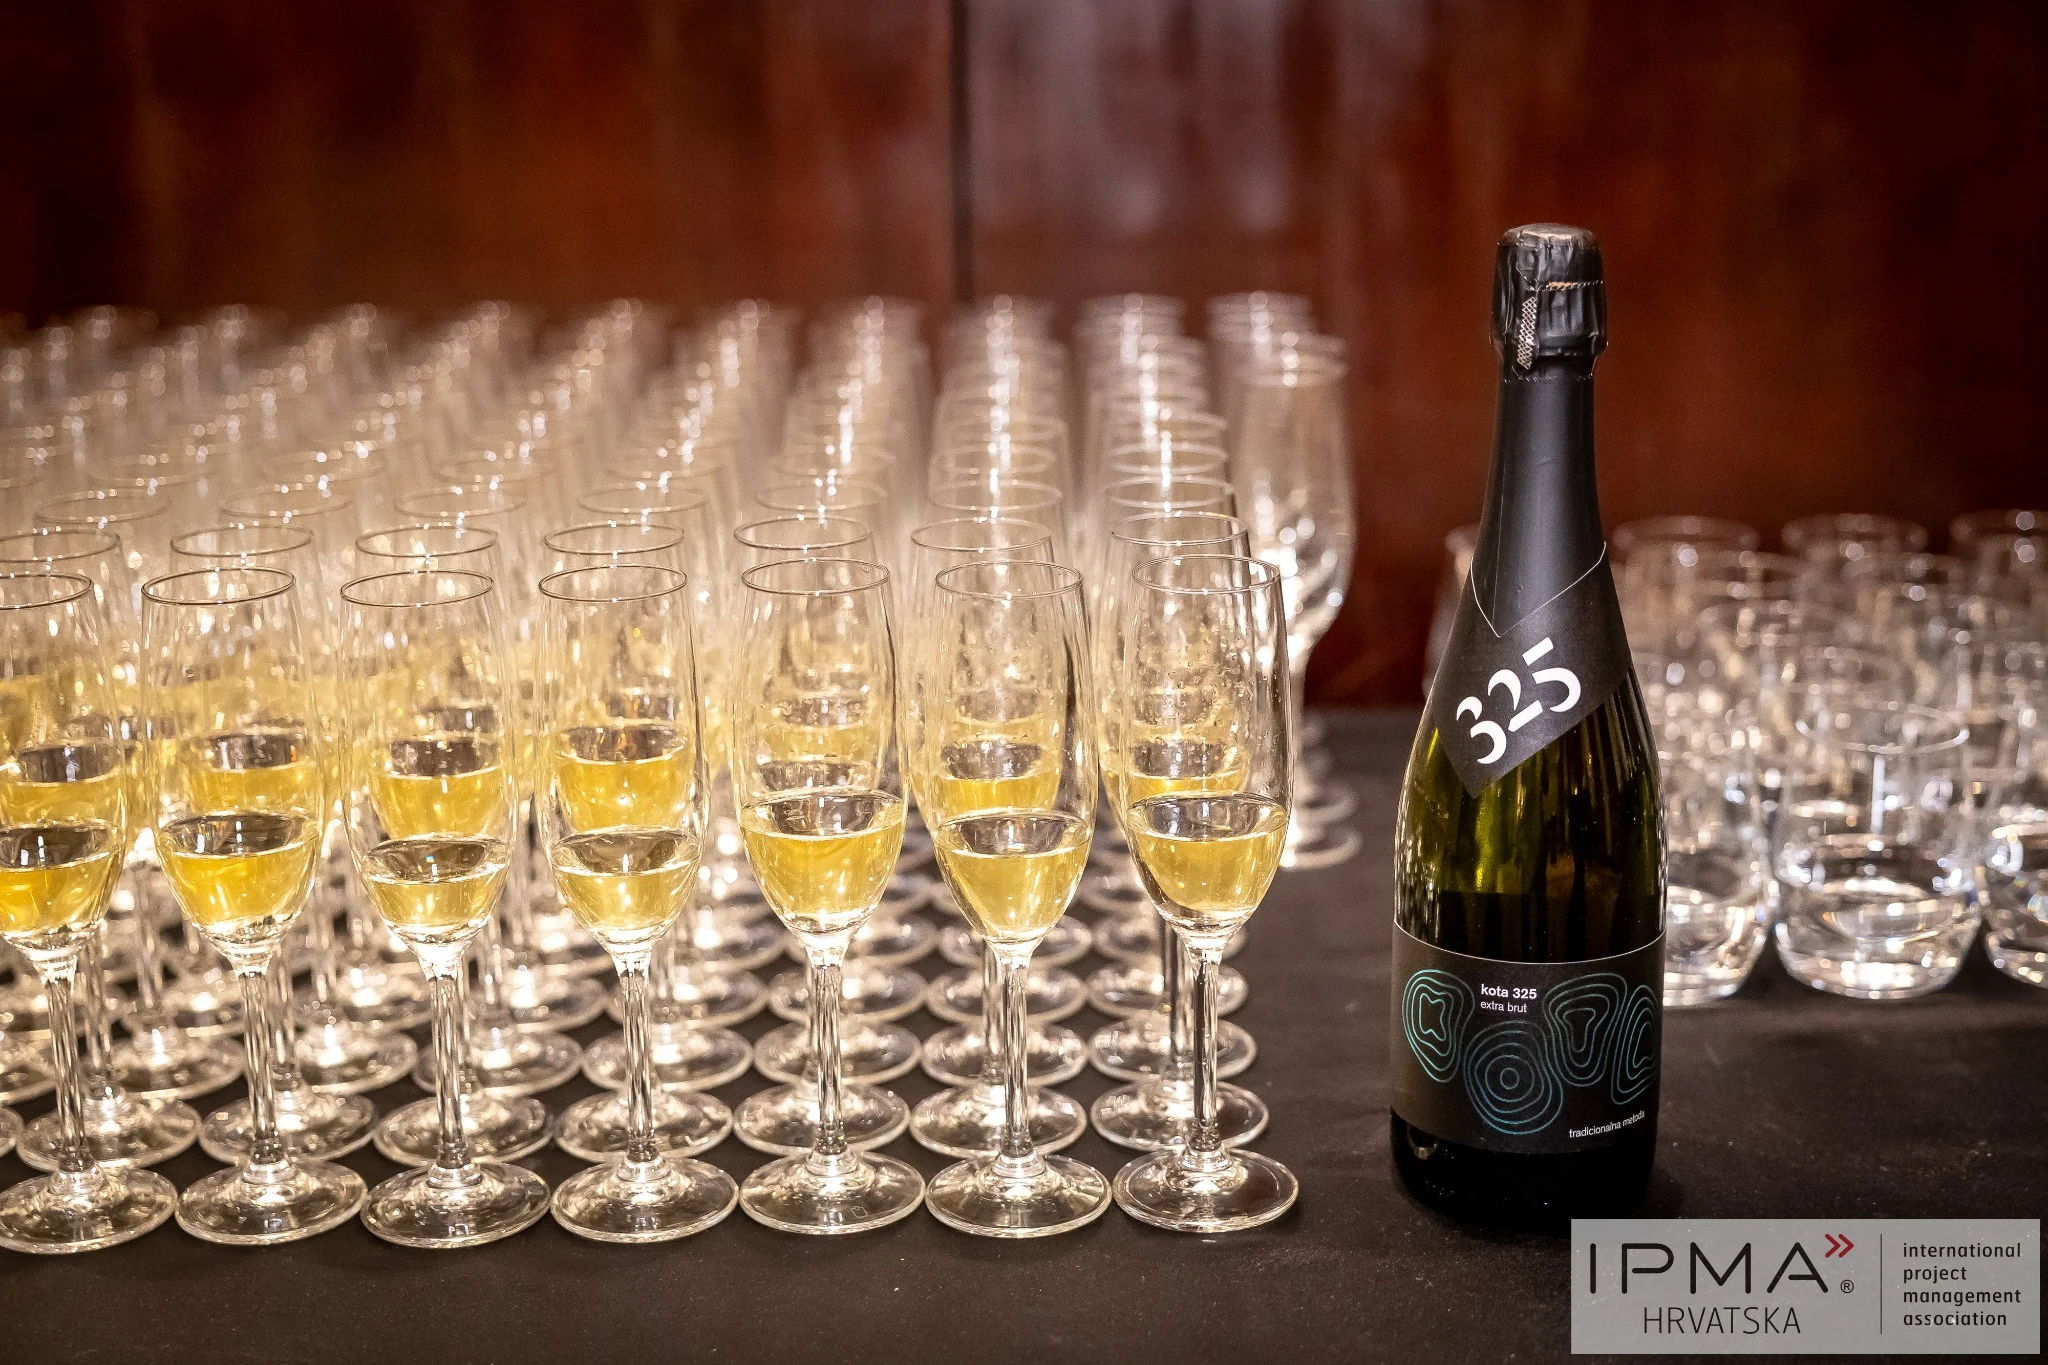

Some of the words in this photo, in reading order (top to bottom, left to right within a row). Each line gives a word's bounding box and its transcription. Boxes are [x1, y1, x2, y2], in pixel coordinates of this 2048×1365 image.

[1456, 636, 1582, 765] 325
[1480, 983, 1509, 998] kota
[1512, 986, 1538, 1000] 325
[1480, 1000, 1505, 1012] extra
[1507, 1001, 1528, 1013] brut
[1568, 1121, 1622, 1139] tradicionalna
[1622, 1109, 1646, 1127] metoda
